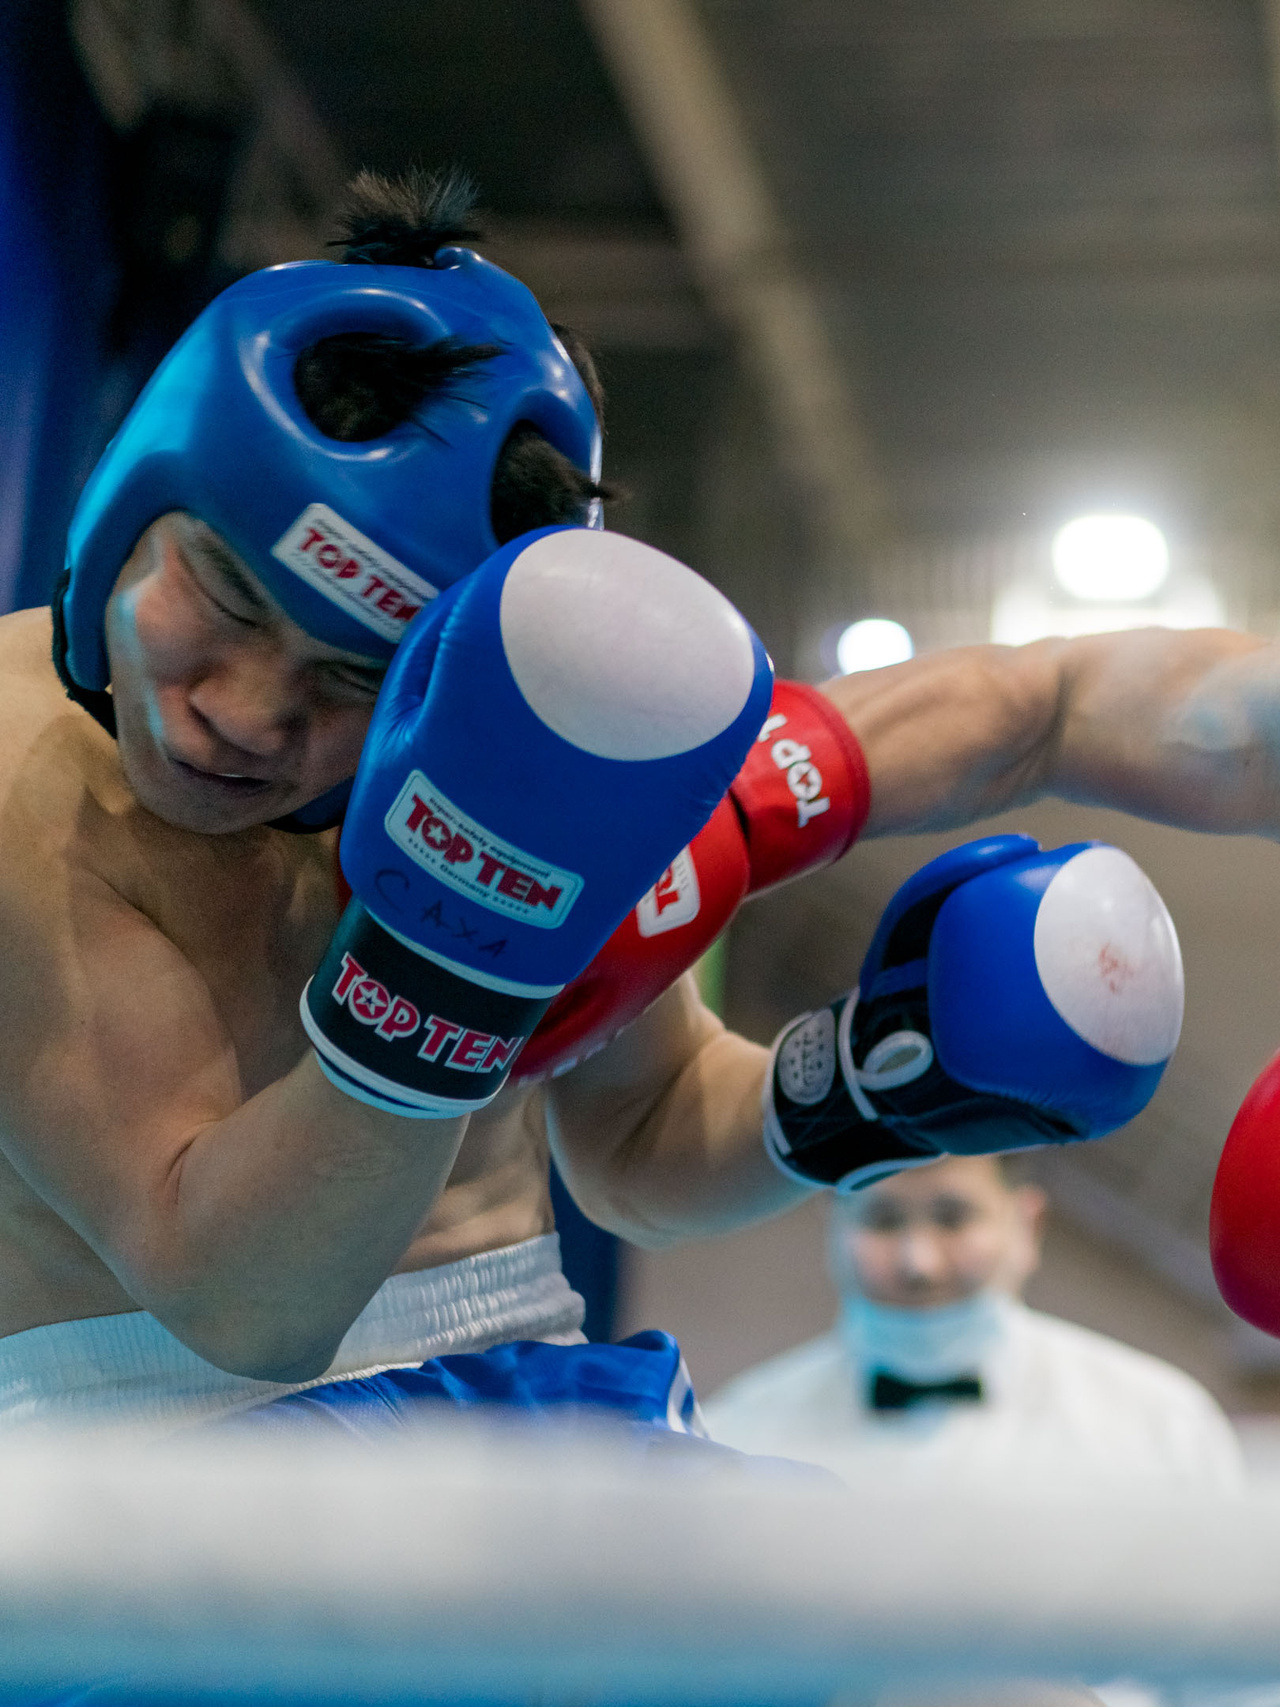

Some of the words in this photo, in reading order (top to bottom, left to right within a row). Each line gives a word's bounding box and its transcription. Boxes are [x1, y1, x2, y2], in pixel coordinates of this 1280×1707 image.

[299, 527, 361, 579] TOP
[770, 737, 831, 829] TOP
[405, 793, 475, 865] TOP
[475, 851, 563, 911] TEN
[439, 863, 490, 898] Germany
[489, 845, 550, 879] equipment
[331, 951, 421, 1042] TOP
[416, 1013, 525, 1074] TEN
